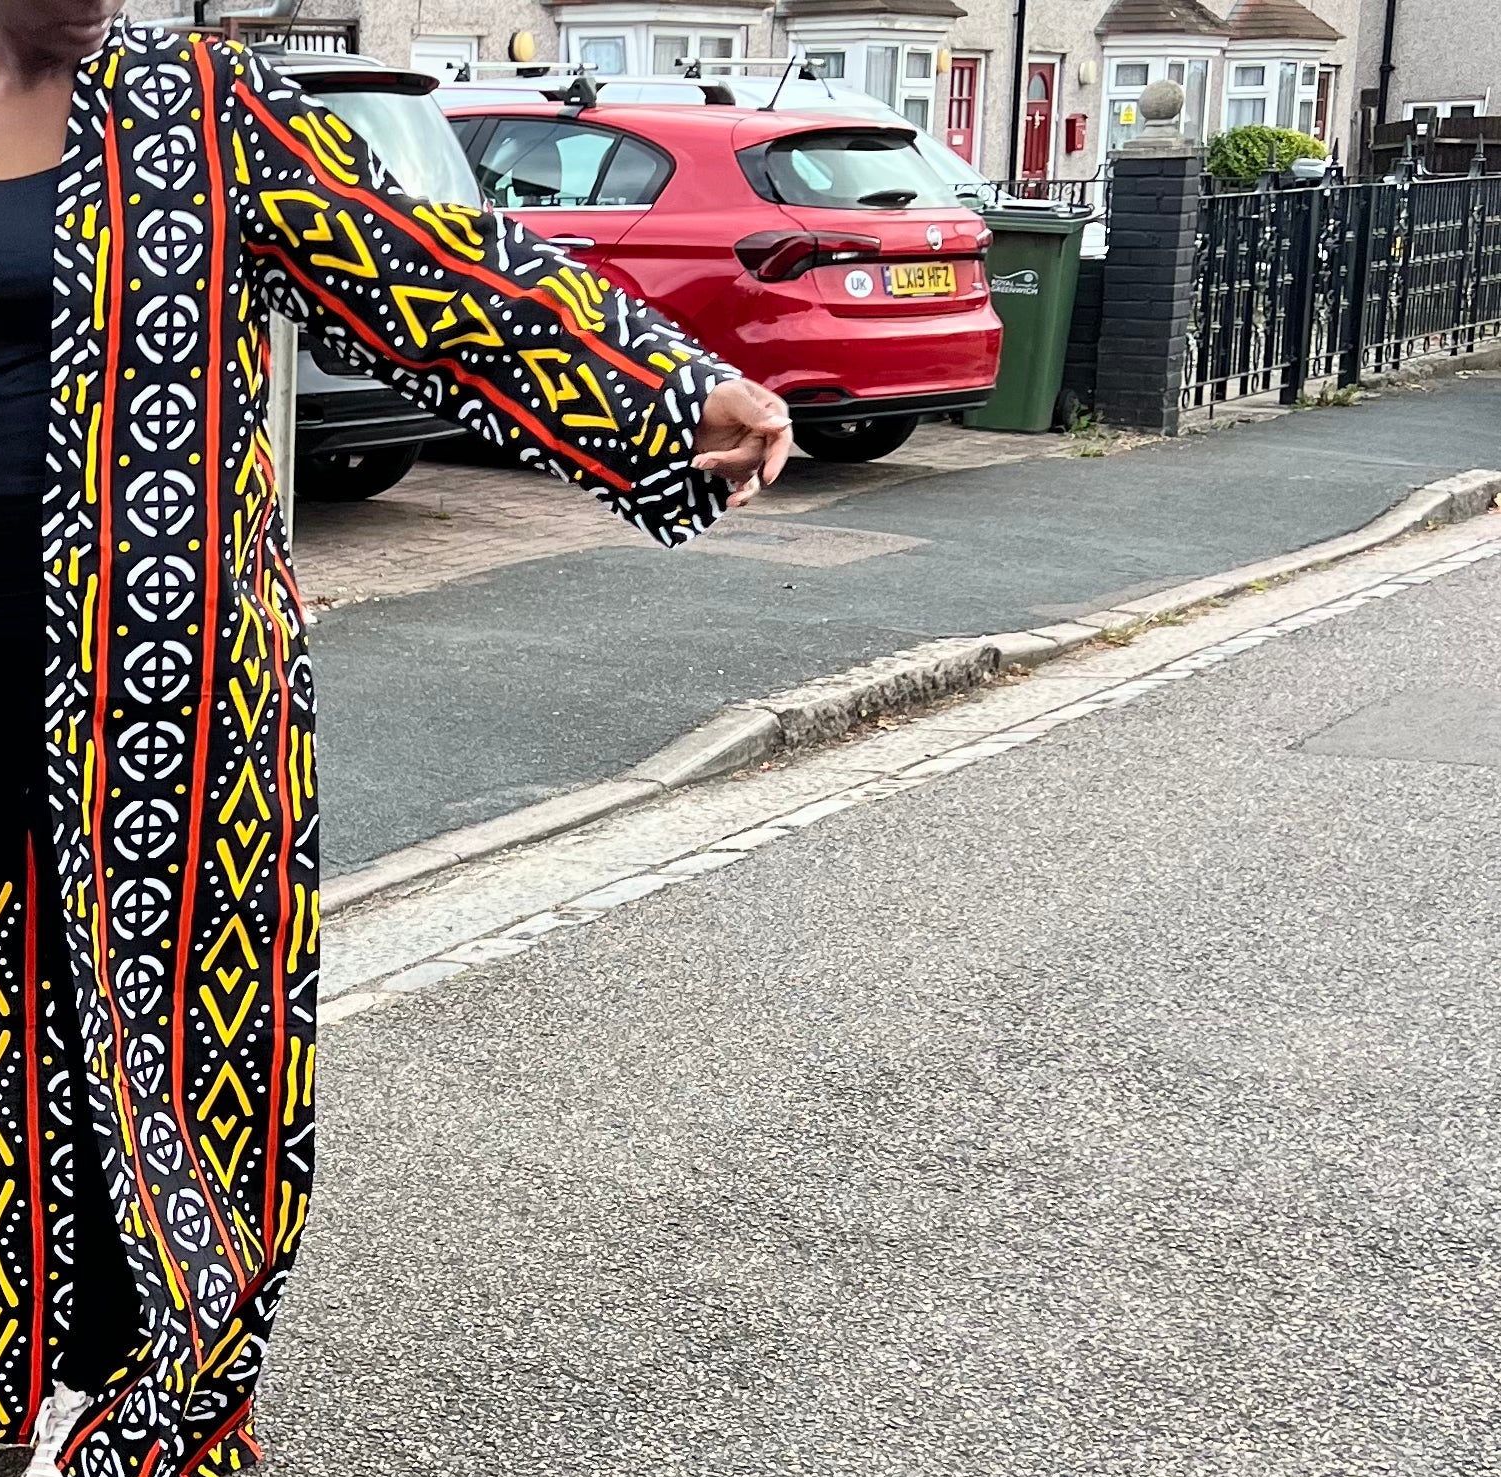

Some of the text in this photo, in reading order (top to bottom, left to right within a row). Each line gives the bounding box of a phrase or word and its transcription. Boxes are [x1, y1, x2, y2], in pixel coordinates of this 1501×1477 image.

[851, 277, 867, 291] UK
[895, 267, 925, 289] LX19
[927, 265, 951, 288] HFZ
